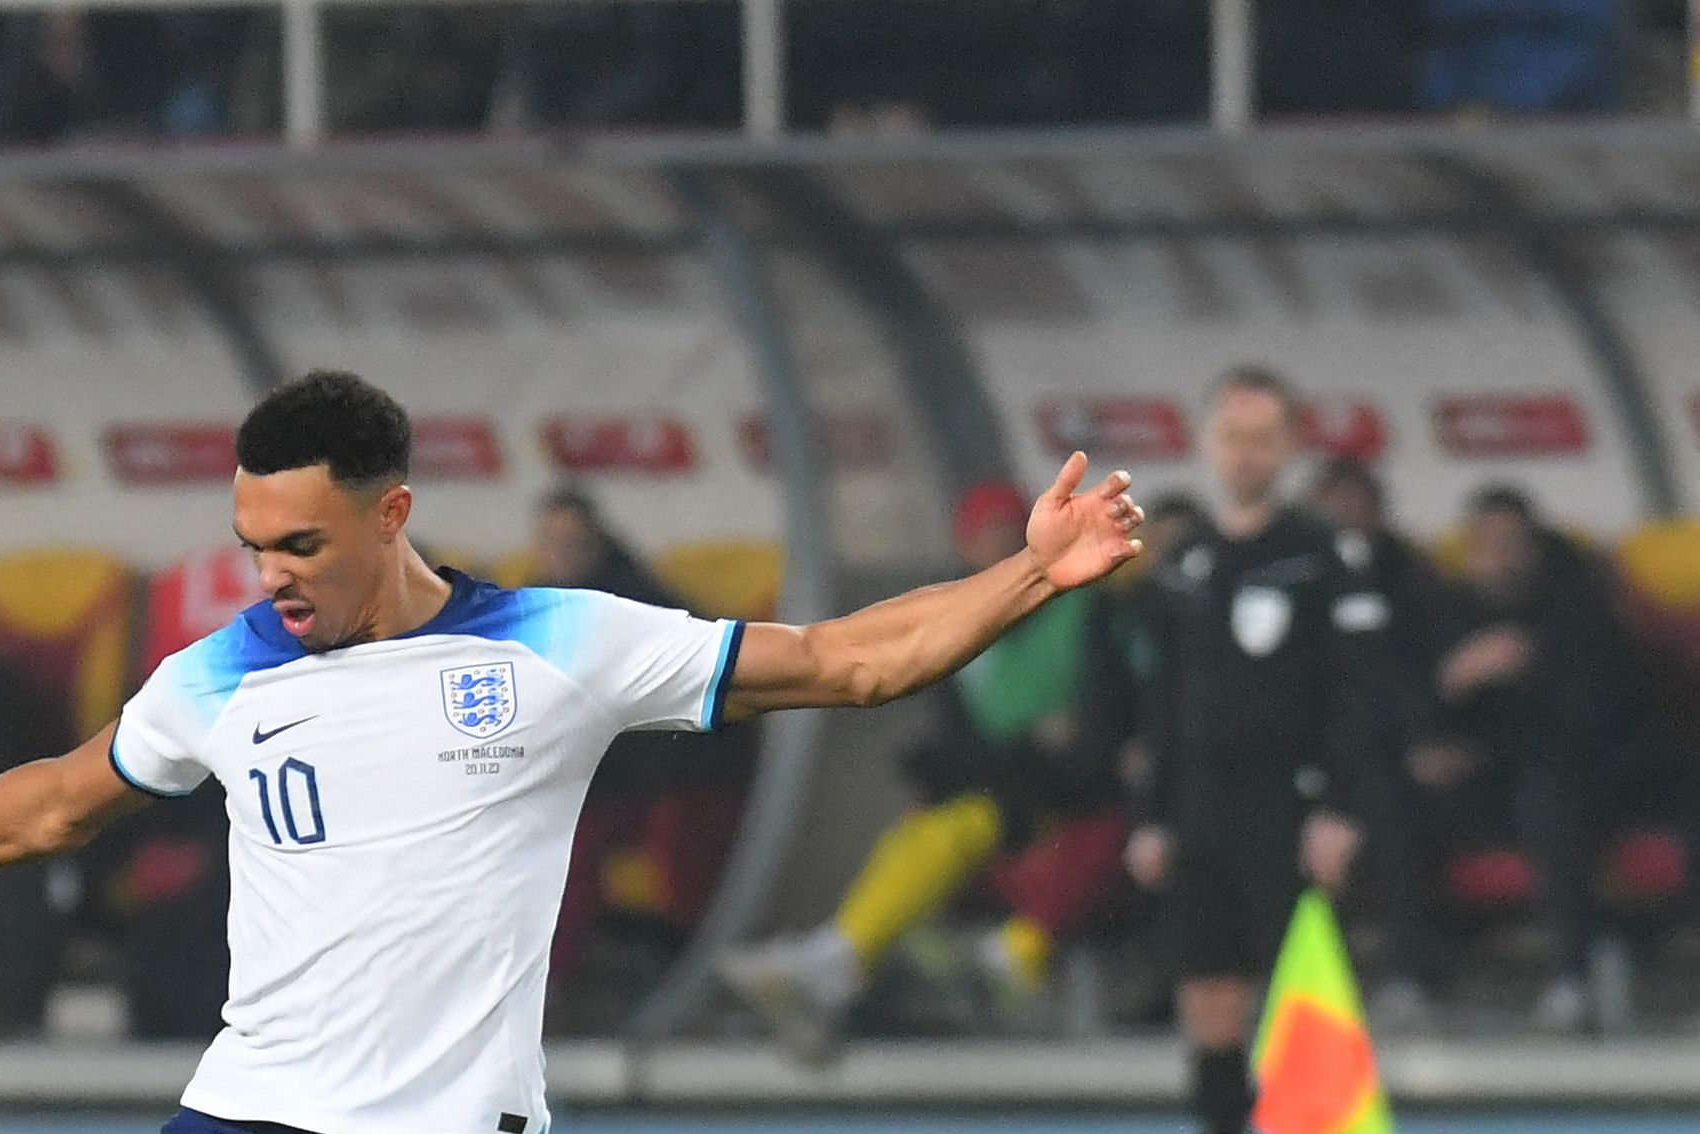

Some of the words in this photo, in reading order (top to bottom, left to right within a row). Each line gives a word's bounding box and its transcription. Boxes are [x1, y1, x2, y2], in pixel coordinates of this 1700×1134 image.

[437, 749, 469, 762] NORTH
[471, 746, 525, 760] MACEDONIA
[248, 755, 327, 845] 10
